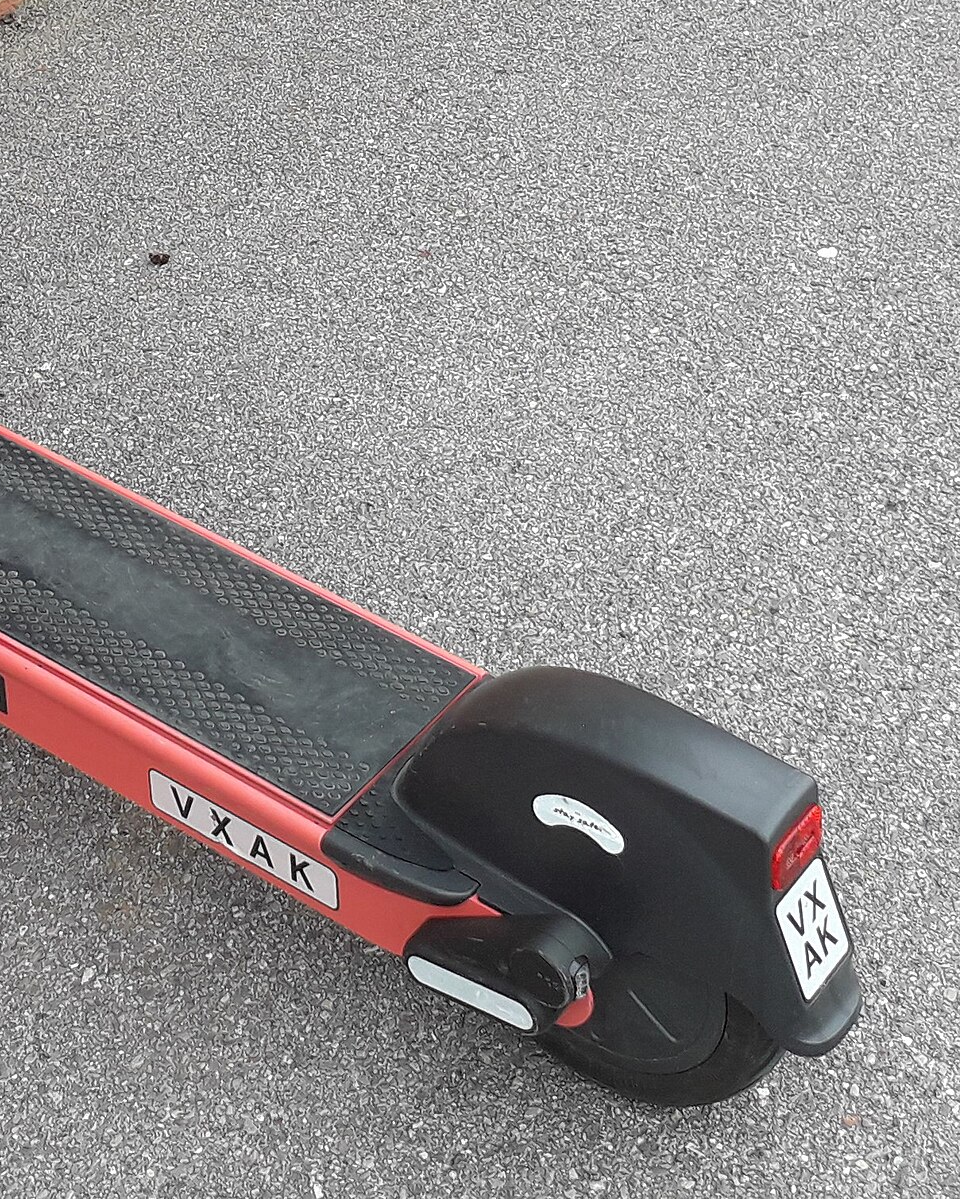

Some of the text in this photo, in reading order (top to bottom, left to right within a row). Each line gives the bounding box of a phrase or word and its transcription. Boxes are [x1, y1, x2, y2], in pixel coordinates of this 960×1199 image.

[170, 785, 314, 893] VXAK
[786, 878, 827, 937] VX
[804, 914, 839, 981] AK
